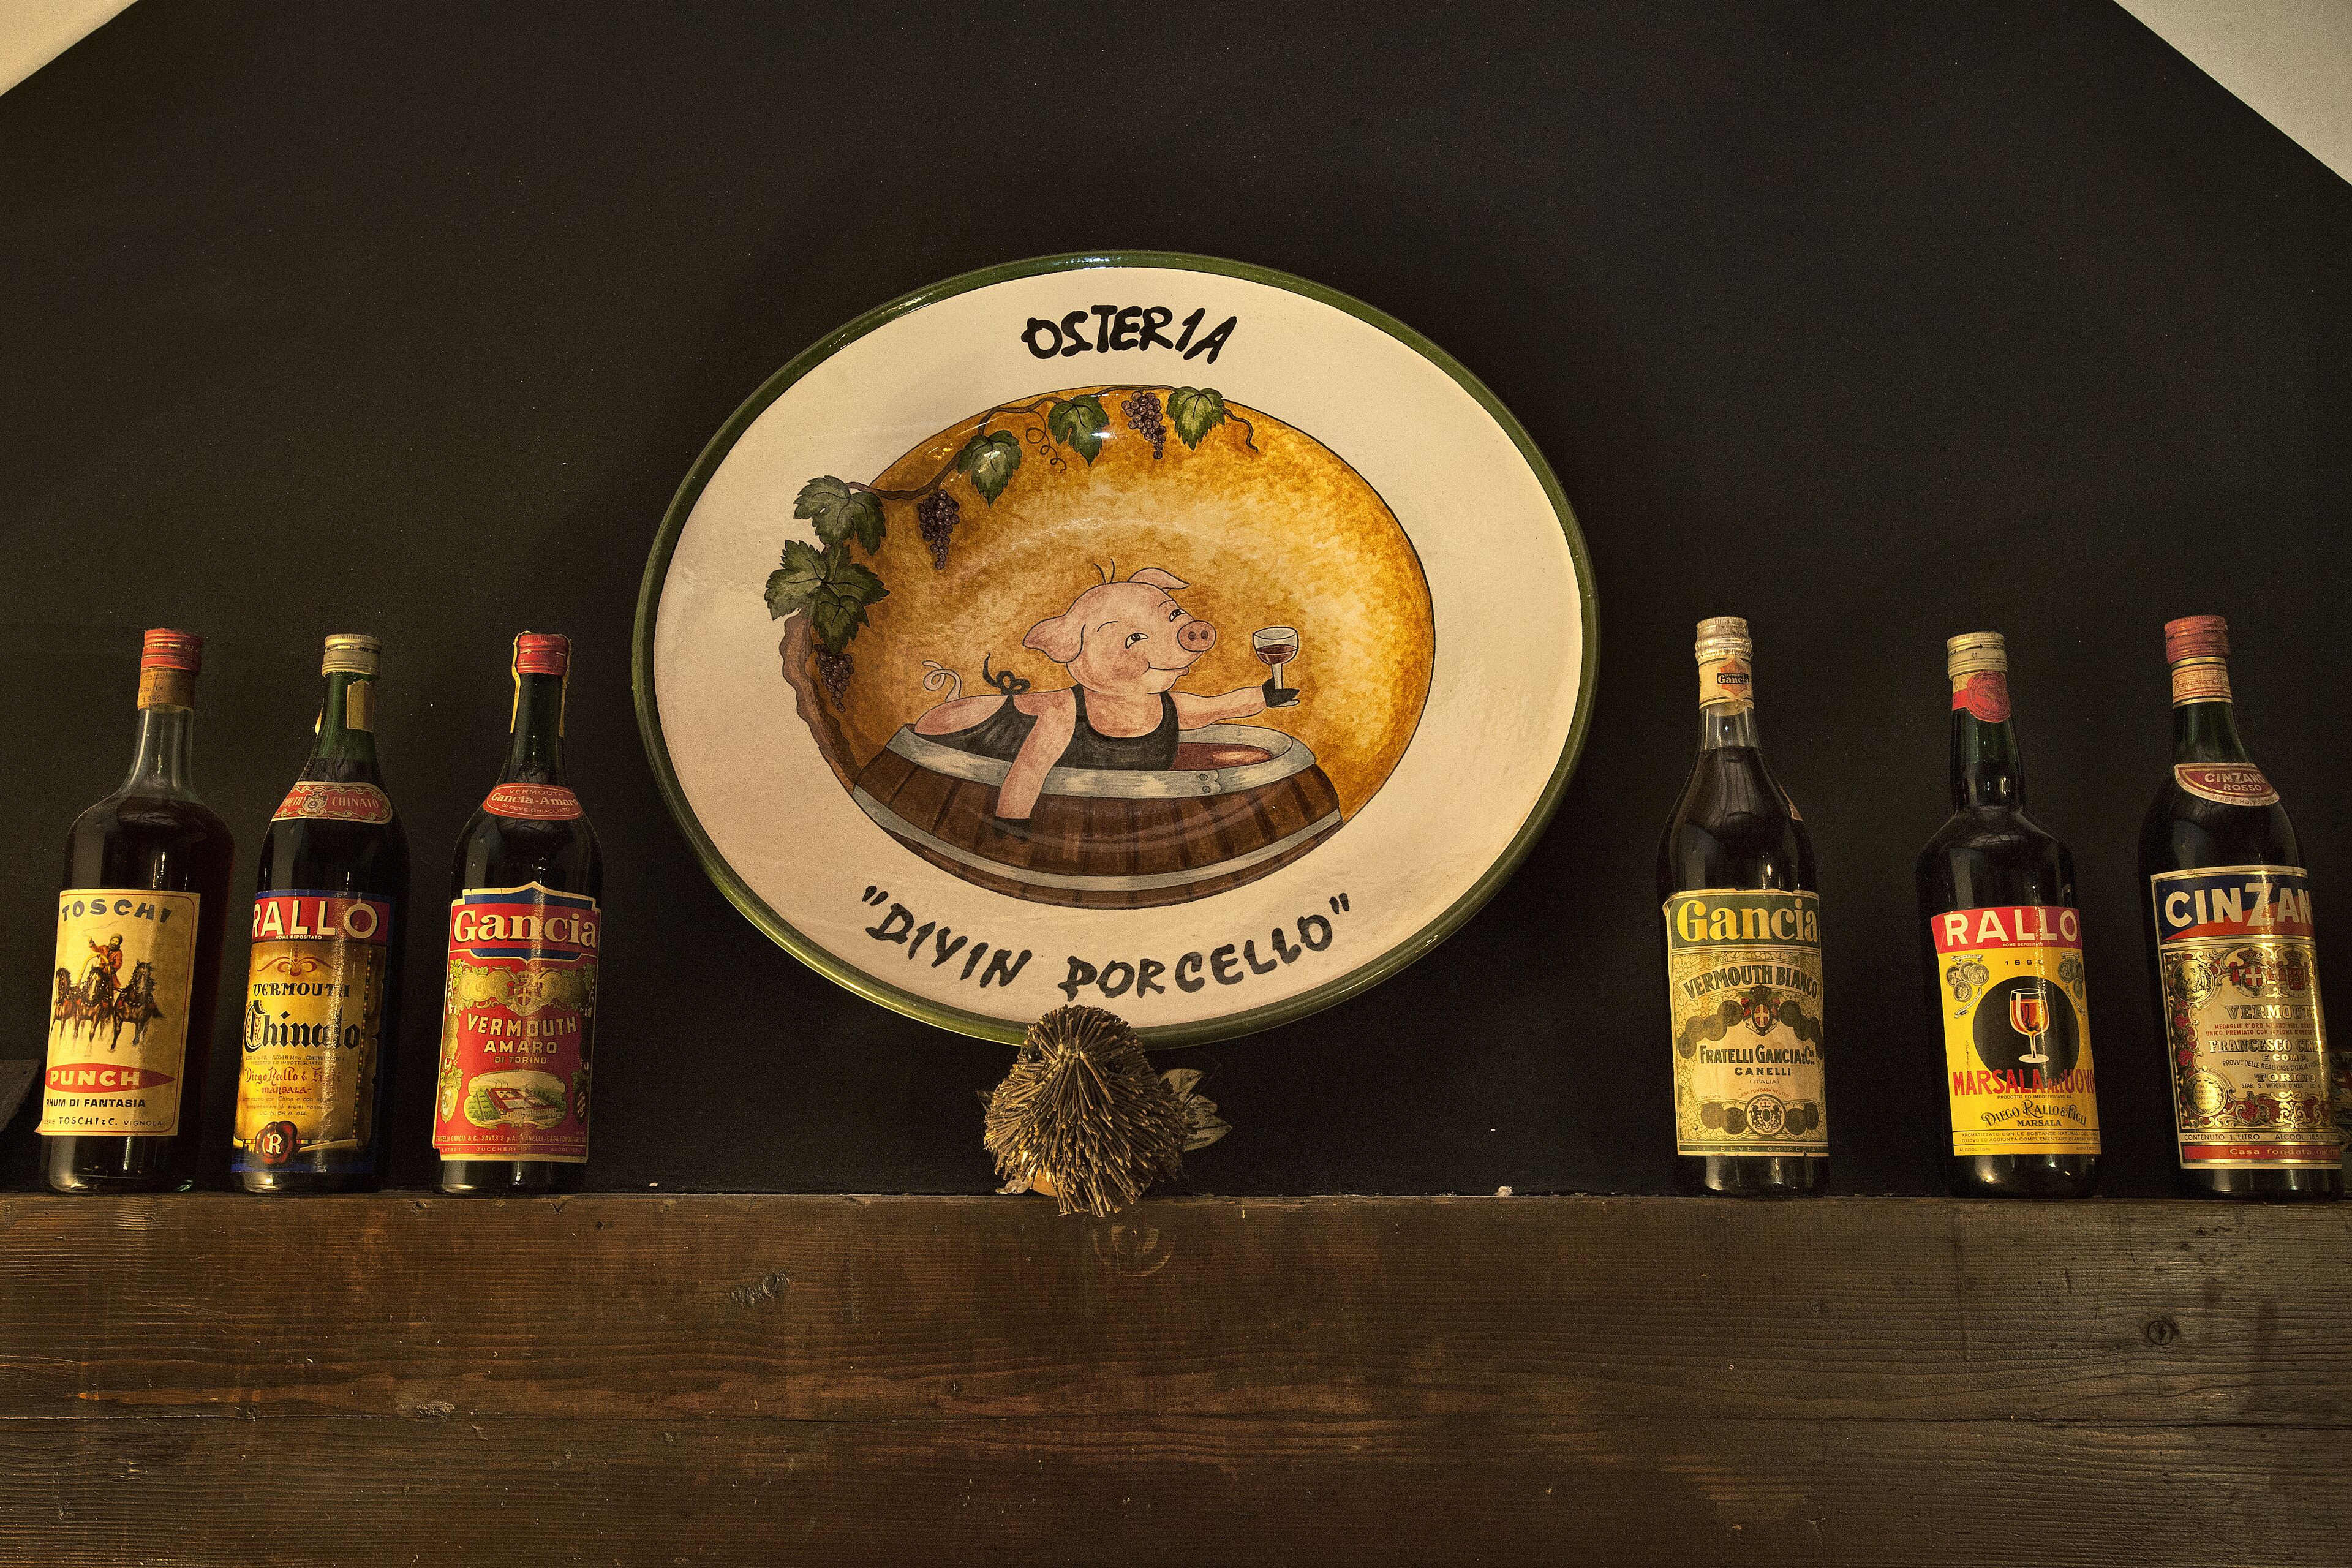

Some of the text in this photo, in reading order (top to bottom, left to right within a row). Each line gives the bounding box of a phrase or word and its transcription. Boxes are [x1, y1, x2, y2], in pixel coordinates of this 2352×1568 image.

[1020, 304, 1237, 364] OSTERIA
[1717, 674, 1749, 684] Gancia
[2204, 772, 2266, 783] CINZANO
[332, 797, 379, 808] CHINATO
[509, 789, 565, 797] VERMOUTH
[62, 899, 172, 924] TOSCHI
[252, 900, 379, 939] RALLO
[1677, 898, 1819, 942] Gancia
[453, 909, 597, 948] Gancia
[1943, 908, 2078, 946] RALLO
[1058, 892, 1350, 1001] PORCELLO"
[253, 982, 350, 997] VERMOUTH
[1683, 965, 1818, 1000] VERMOUTH BIANCO
[244, 999, 361, 1054] Chinato
[467, 1012, 578, 1038] VERMOUTH
[483, 1040, 558, 1054] AMARO
[1700, 1044, 1802, 1065] FRATELLI GANCIA
[2209, 1038, 2292, 1053] FRANCESCO
[509, 1056, 547, 1065] TORINO
[2272, 1054, 2309, 1063] COMP.
[50, 1070, 140, 1086] PUNCH
[244, 1066, 267, 1086] Diego
[1734, 1067, 1792, 1076] CANELLI
[2254, 1073, 2317, 1083] TORINO
[1953, 1069, 2042, 1096] MARSALA
[84, 1099, 146, 1107] FANTASIA
[1981, 1106, 2020, 1127] DIEGO
[2021, 1099, 2059, 1118] RALLO
[59, 1117, 99, 1125] TOSCHI
[266, 1133, 283, 1155] R
